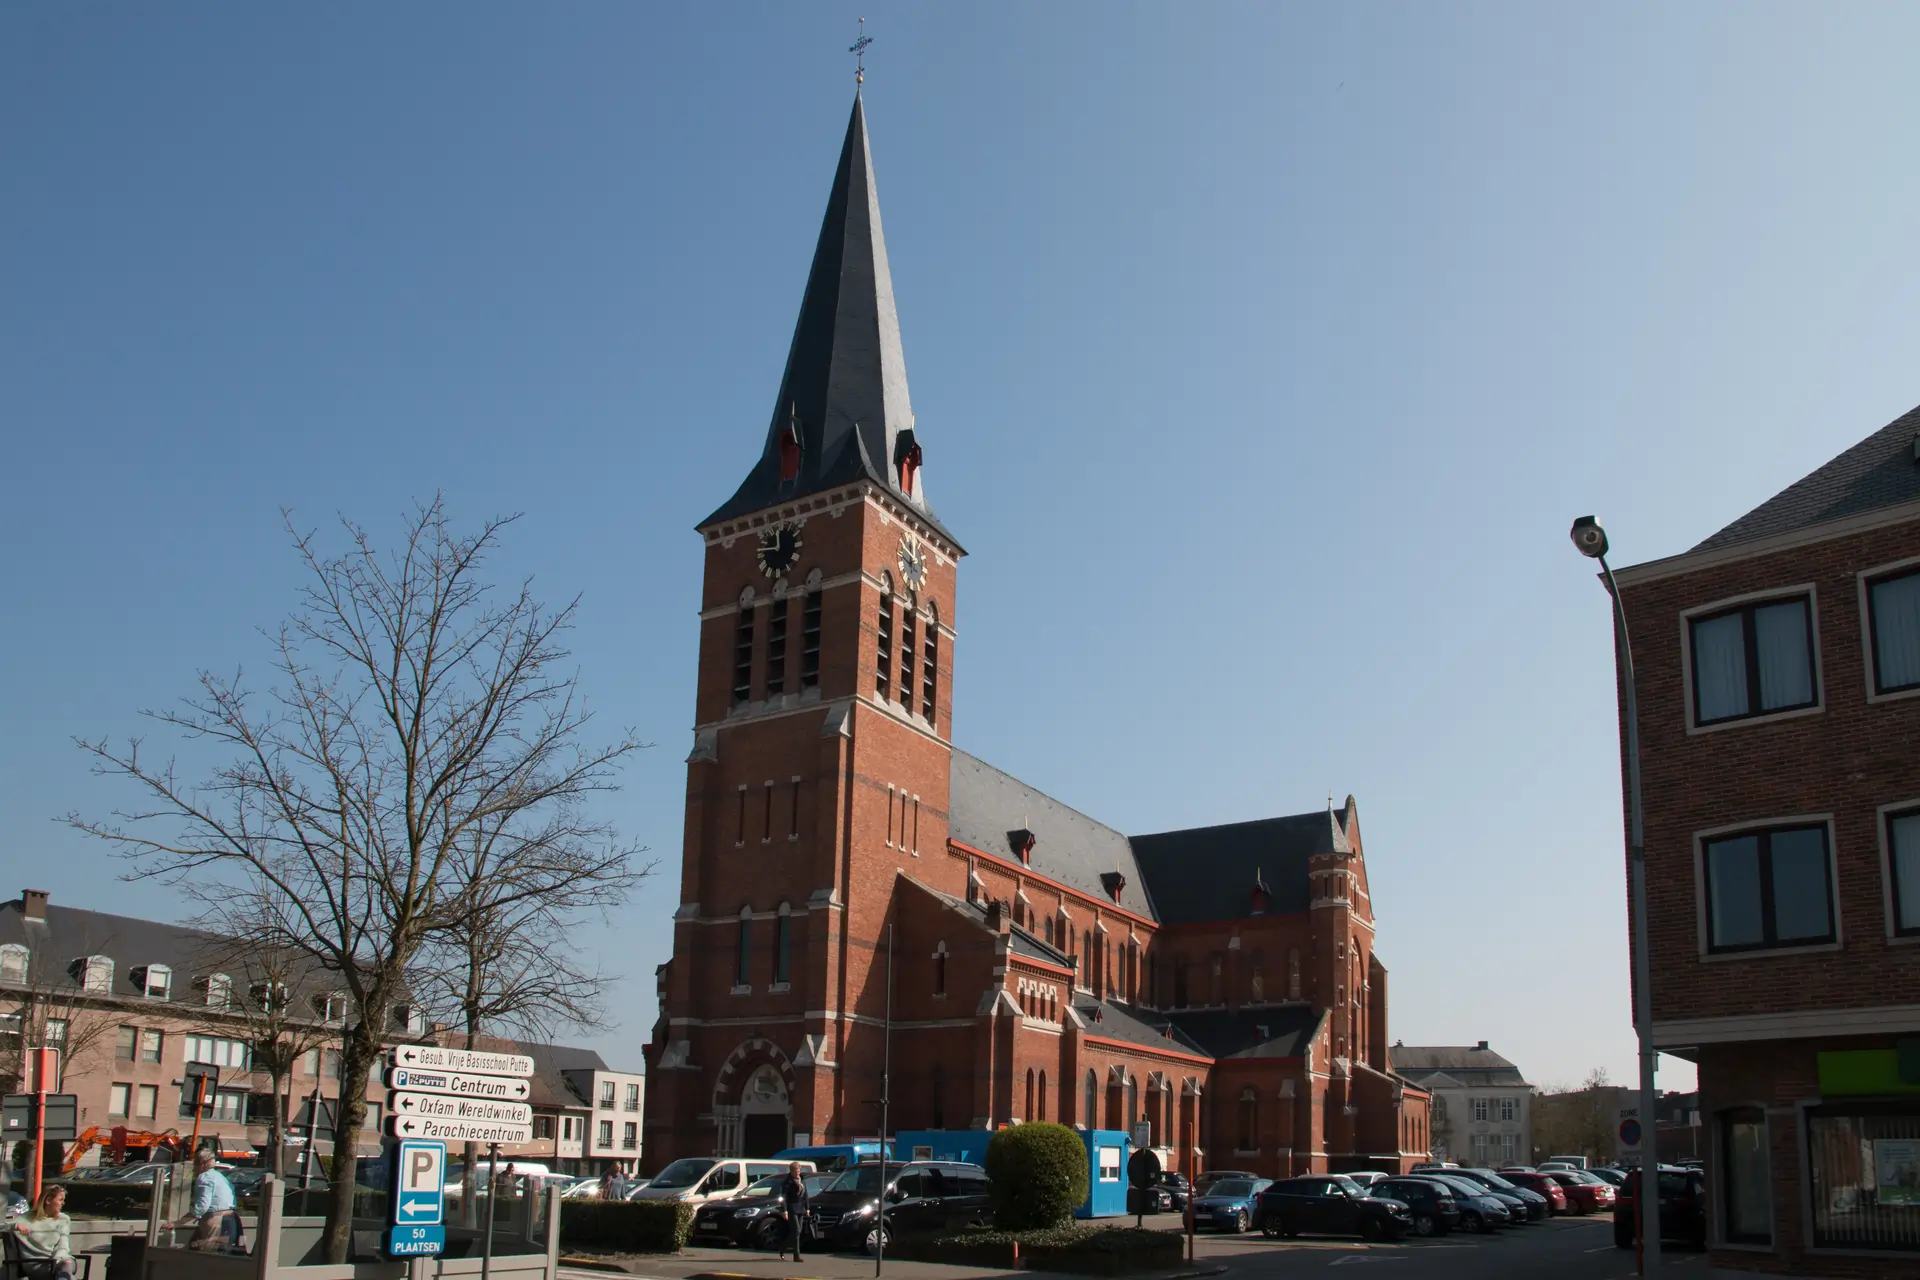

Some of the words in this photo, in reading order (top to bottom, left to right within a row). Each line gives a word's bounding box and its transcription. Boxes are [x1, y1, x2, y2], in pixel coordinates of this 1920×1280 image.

[420, 1049, 444, 1065] Gesub.
[448, 1052, 464, 1070] Vrije
[466, 1053, 509, 1071] Basisschool
[509, 1057, 529, 1073] Putte
[419, 1078, 445, 1087] PUTTE
[451, 1077, 507, 1095] Centrum
[419, 1098, 454, 1116] Oxfam
[458, 1101, 527, 1121] Wereldwinkel
[1620, 1108, 1638, 1118] ZONE
[423, 1120, 525, 1142] Parochiecentrum
[410, 1151, 433, 1188] P
[412, 1228, 426, 1239] 50
[394, 1242, 441, 1253] PLAATSEN
